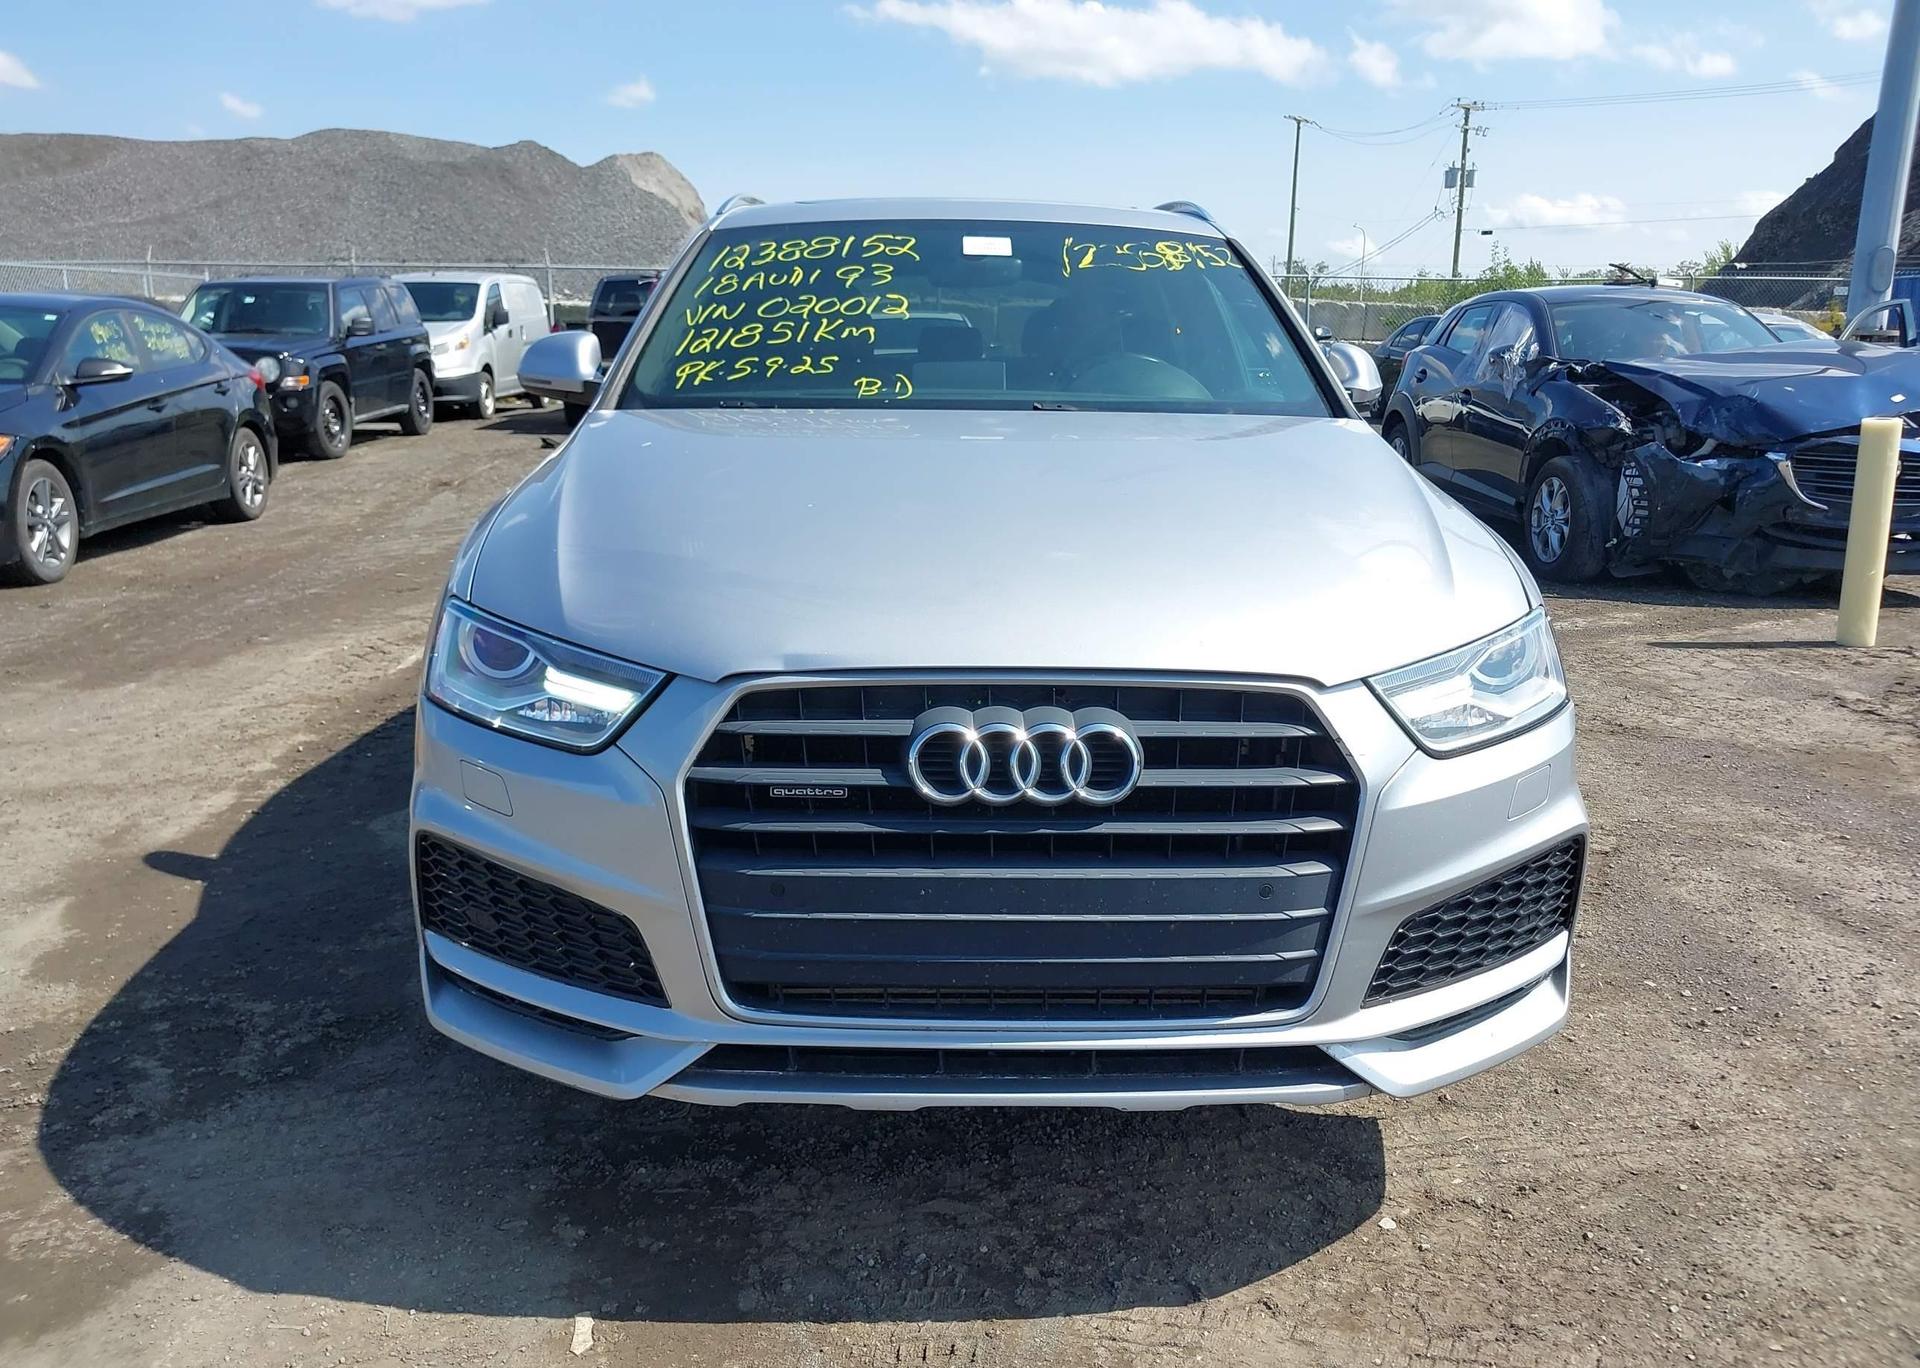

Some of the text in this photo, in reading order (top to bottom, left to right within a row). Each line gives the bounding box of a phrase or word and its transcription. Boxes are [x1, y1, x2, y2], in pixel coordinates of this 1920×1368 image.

[708, 235, 920, 272] 12388152
[686, 301, 746, 326] VIN
[773, 787, 844, 796] quattro
